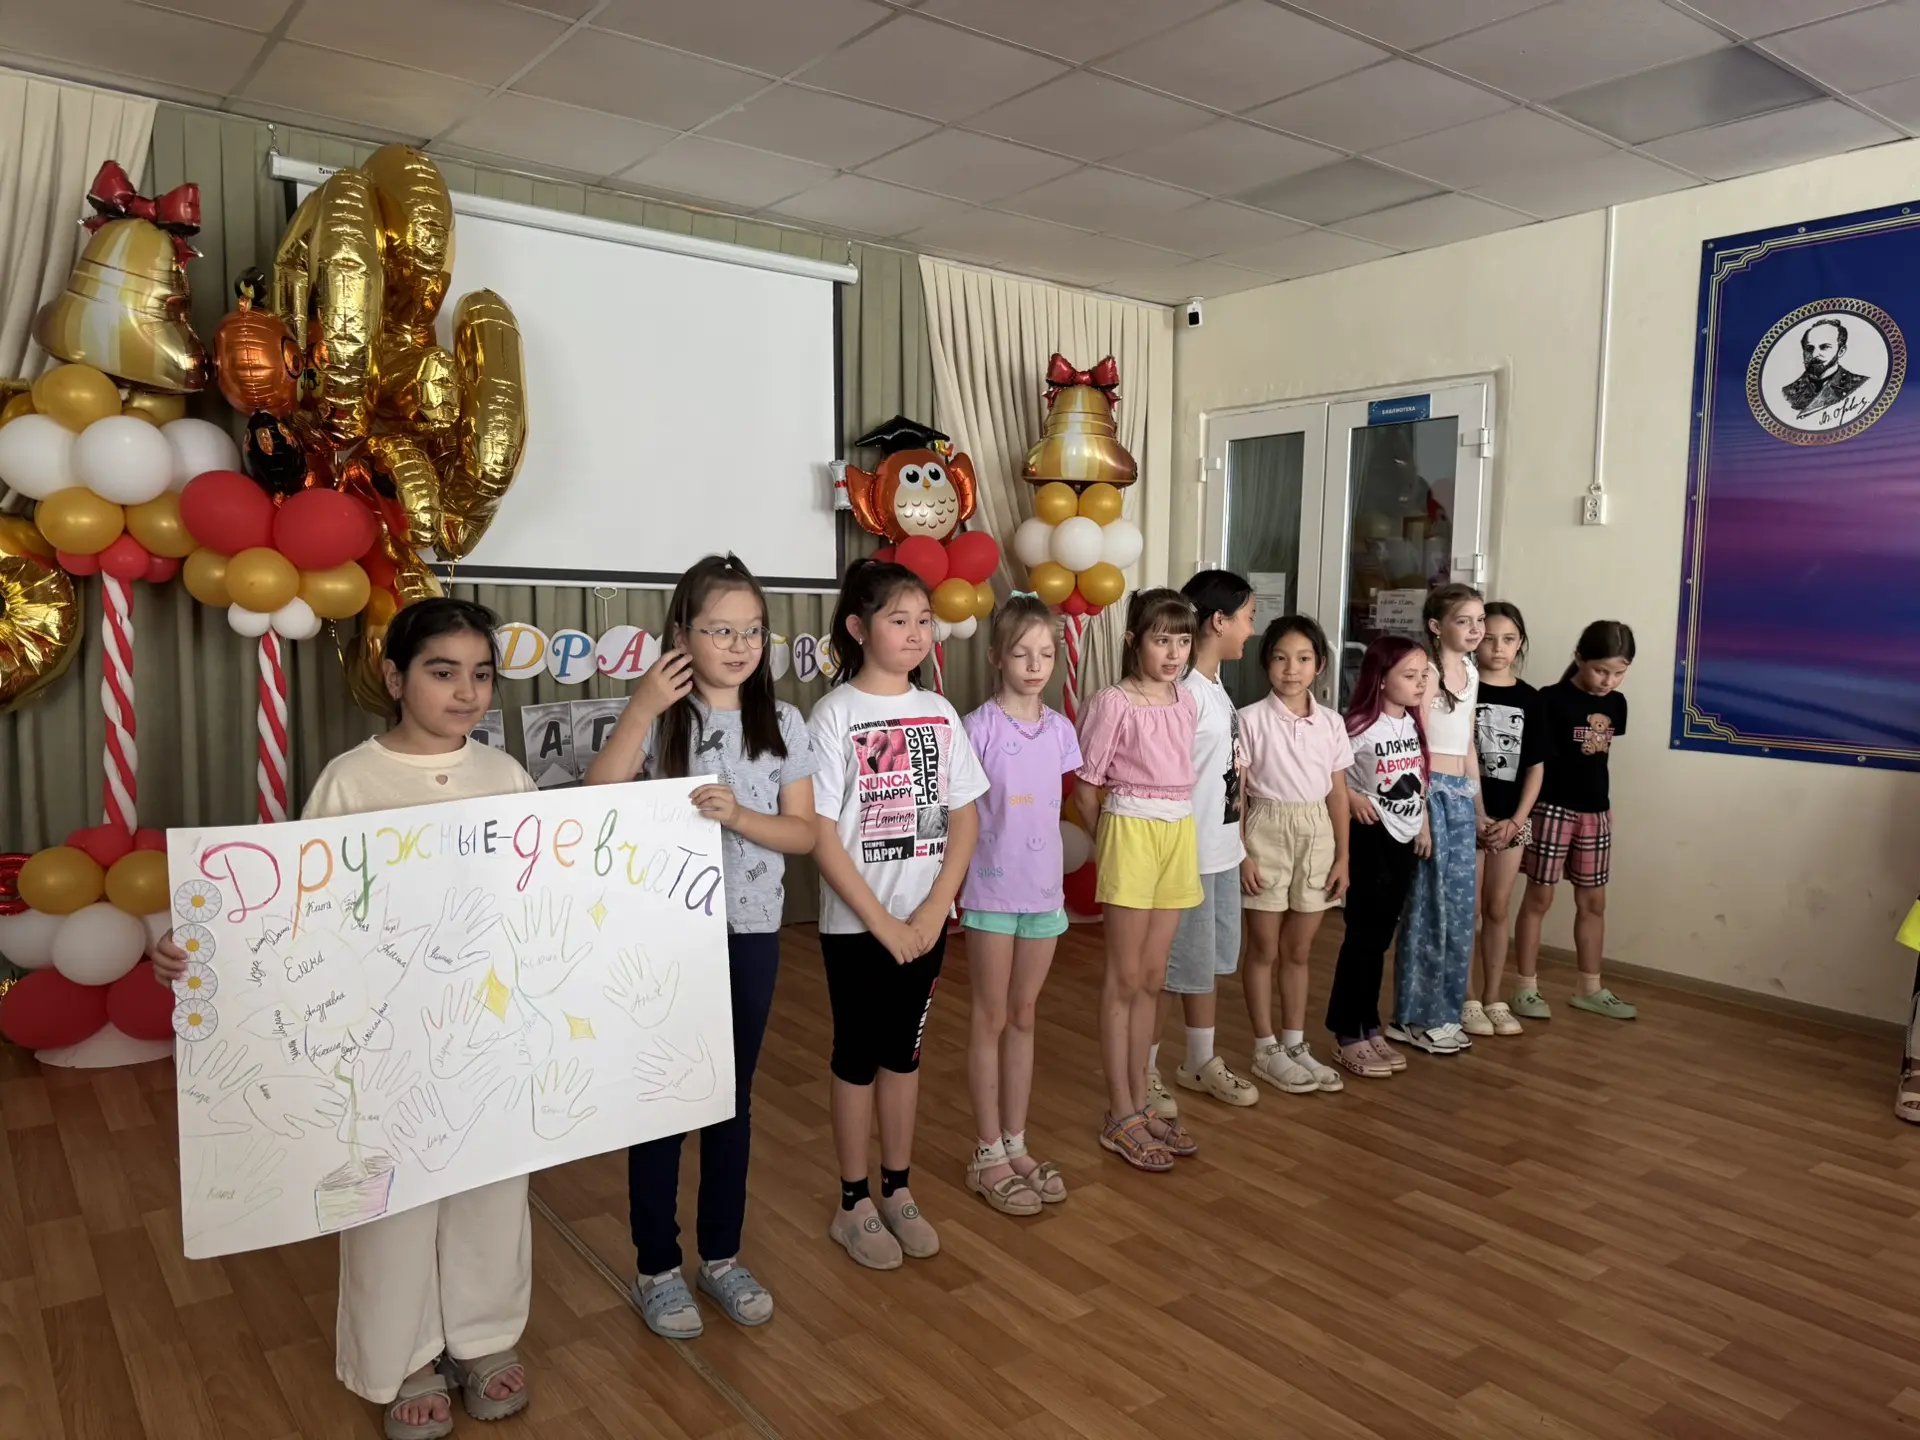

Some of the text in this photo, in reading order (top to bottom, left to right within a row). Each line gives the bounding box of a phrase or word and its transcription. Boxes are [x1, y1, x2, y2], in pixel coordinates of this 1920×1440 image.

[1375, 738, 1420, 757] ДЛЯ МЕН
[905, 727, 926, 806] FLAMINGO
[921, 726, 940, 804] COUTURE
[859, 774, 912, 792] NUNCA
[859, 787, 913, 804] UNHAPPY
[1379, 798, 1416, 816] МОЙ
[859, 804, 915, 836] Flamingo
[864, 847, 904, 863] HAPPY
